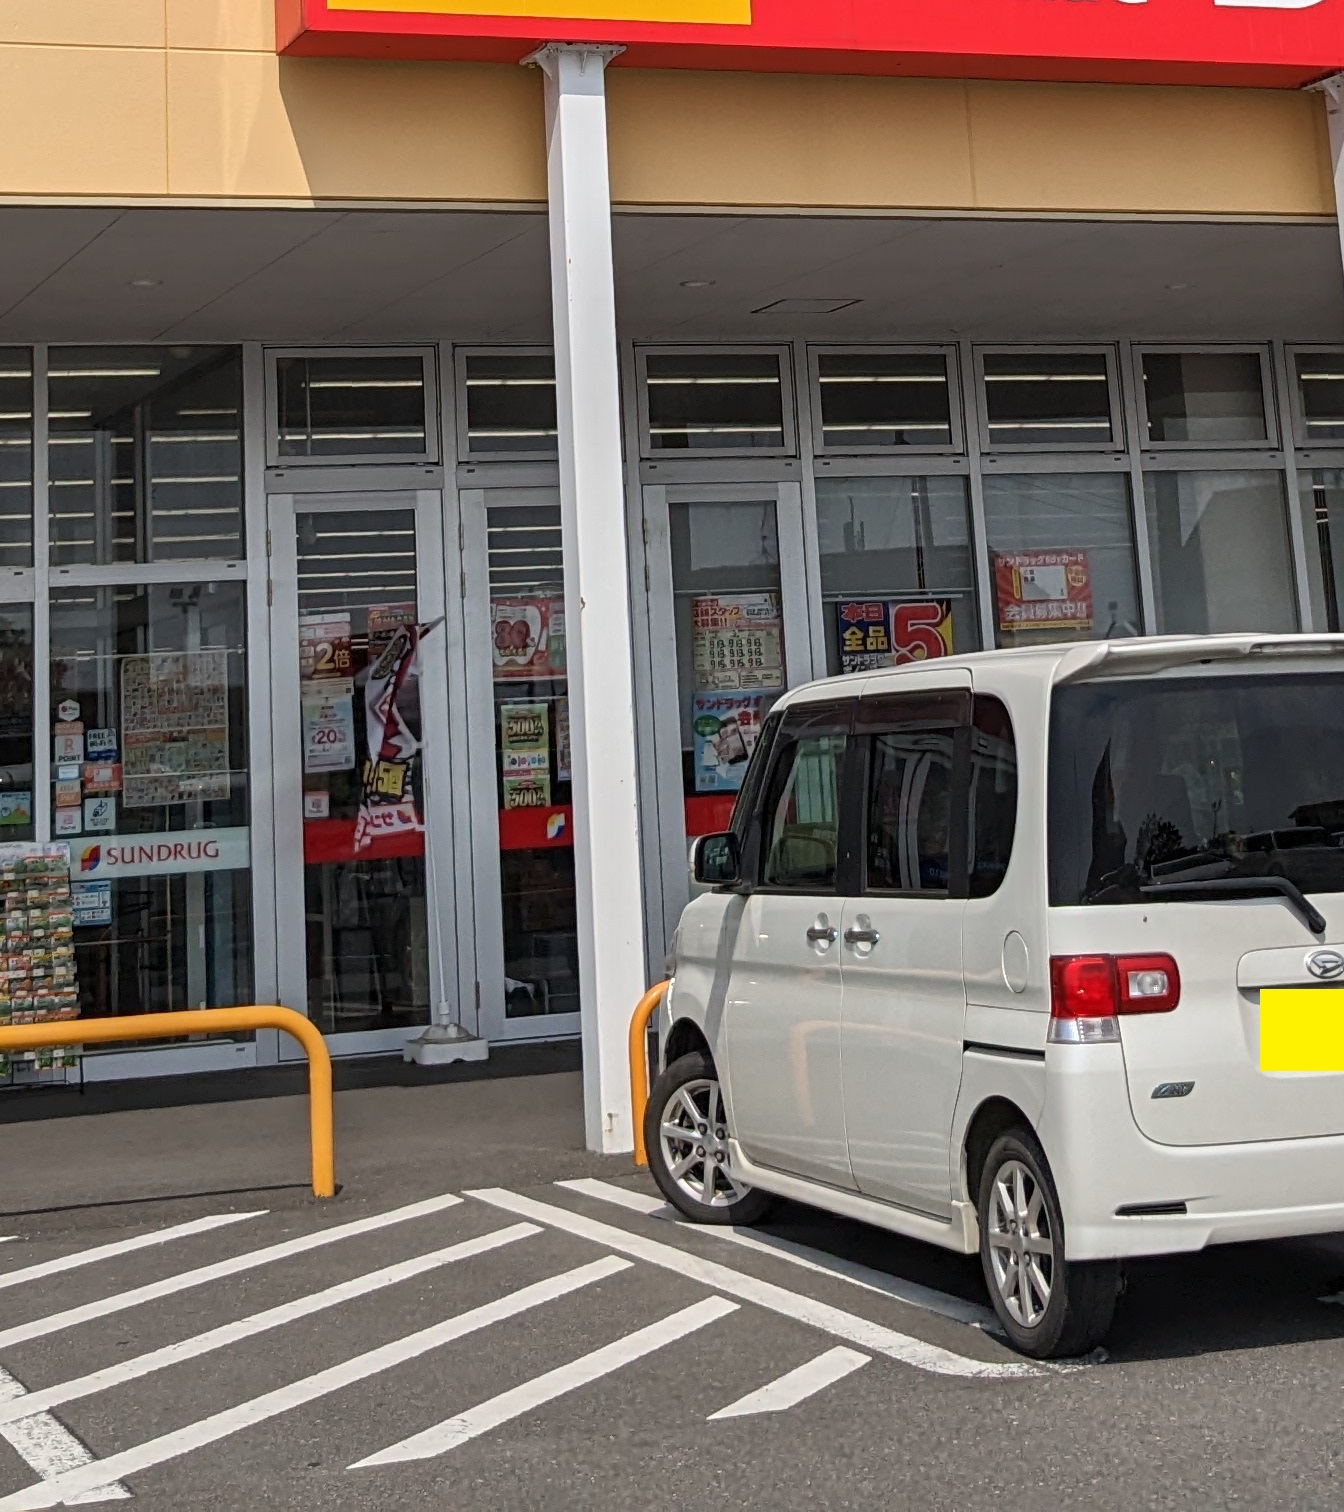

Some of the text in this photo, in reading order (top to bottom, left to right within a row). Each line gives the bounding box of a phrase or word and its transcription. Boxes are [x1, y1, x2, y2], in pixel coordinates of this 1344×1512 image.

[841, 603, 884, 622] 本日
[842, 625, 888, 652] 全品
[106, 840, 220, 866] SUNDRUG
